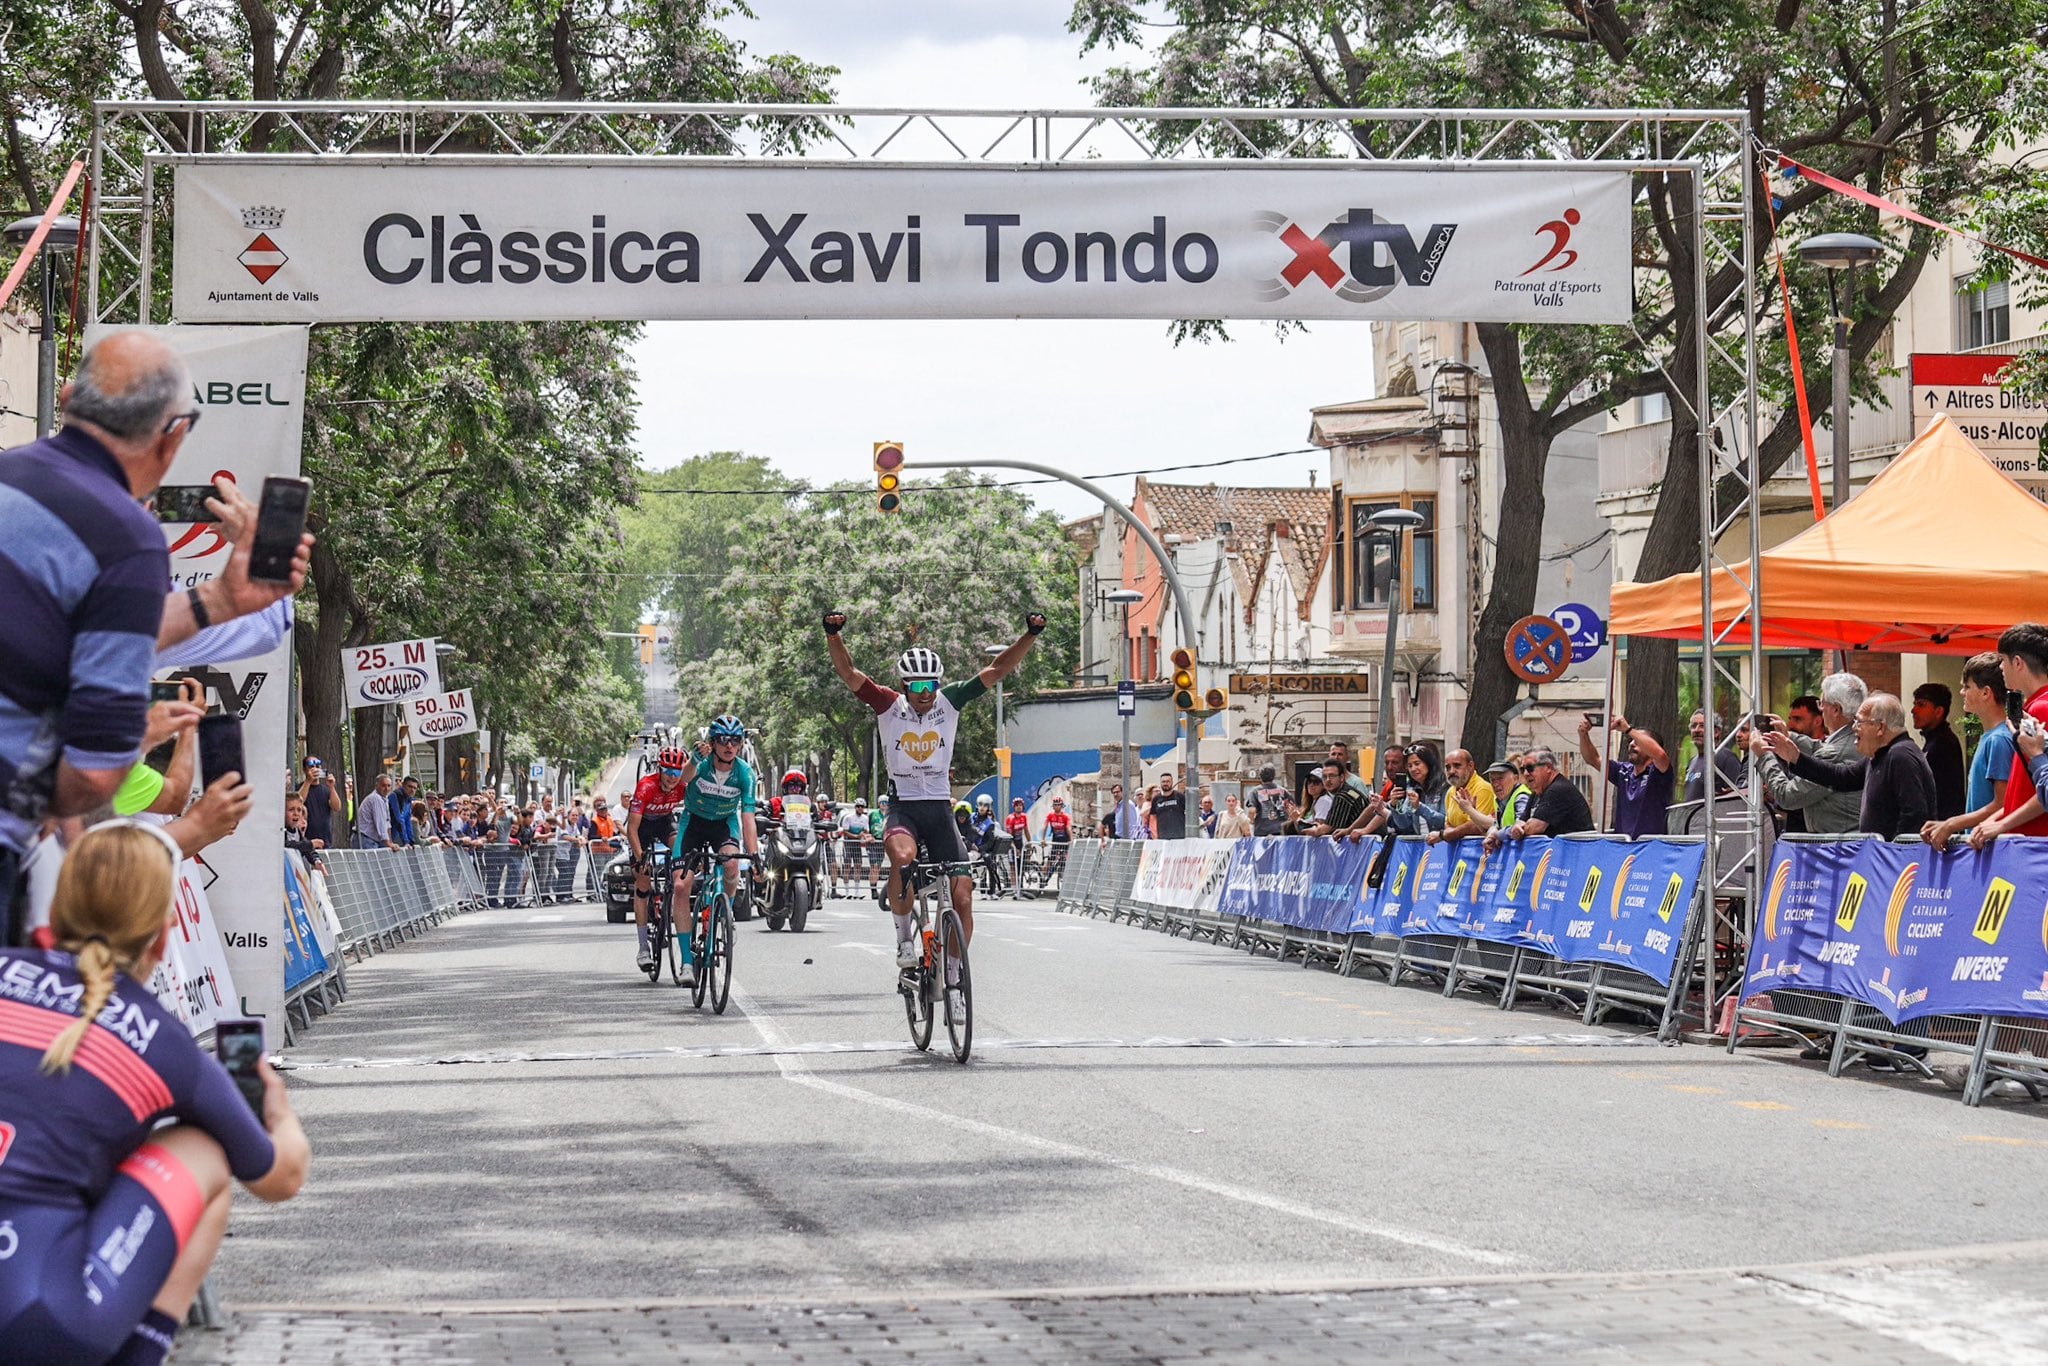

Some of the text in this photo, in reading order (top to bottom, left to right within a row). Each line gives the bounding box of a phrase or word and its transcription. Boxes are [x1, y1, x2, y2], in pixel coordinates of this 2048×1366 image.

[363, 213, 1219, 284] Clàssica Xavi Tondo
[1494, 280, 1602, 296] Patronat d'Esports
[208, 291, 319, 303] Ajuntament de Valls
[1533, 293, 1564, 307] Valls
[1946, 390, 1994, 409] Altres
[1554, 611, 1582, 637] P
[356, 642, 426, 672] 25. M
[370, 674, 421, 695] ROCAUTO
[415, 692, 466, 717] 50. M
[425, 716, 463, 733] ROCAUTO
[895, 737, 946, 751] ZAMORA
[534, 767, 542, 776] P
[1581, 874, 1600, 904] IN
[1628, 883, 1649, 893] CATALANA
[1790, 880, 1820, 890] FEDERACIÓ
[1916, 885, 1952, 899] FEDERACIÓ
[1660, 881, 1681, 914] IN
[1787, 895, 1817, 904] CATALANA
[1838, 883, 1863, 920] IN
[1784, 909, 1815, 921] CICLISME
[1912, 905, 1947, 916] CATALANA
[1977, 889, 2010, 931] IN
[1907, 923, 1944, 938] CICLISME
[224, 932, 268, 948] Valls
[1817, 941, 1861, 967] INVERSE
[1951, 956, 2009, 982] INVERSE
